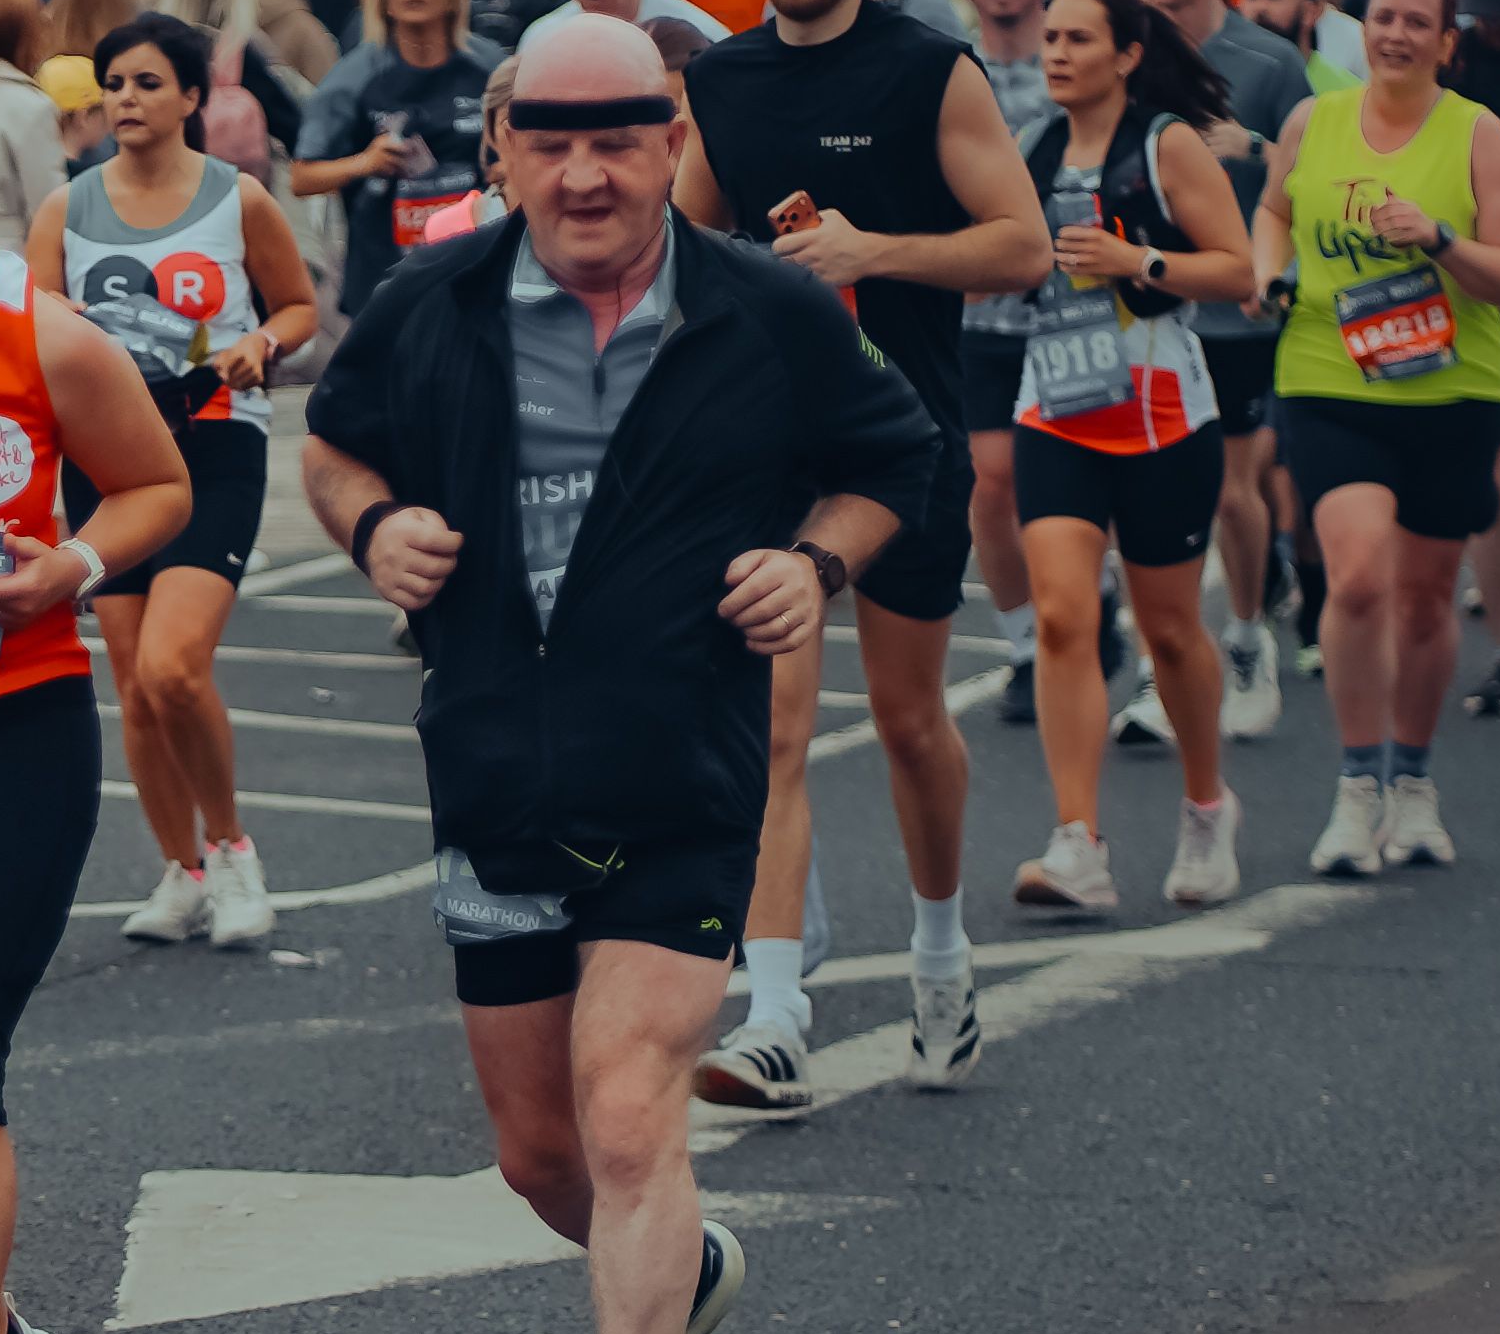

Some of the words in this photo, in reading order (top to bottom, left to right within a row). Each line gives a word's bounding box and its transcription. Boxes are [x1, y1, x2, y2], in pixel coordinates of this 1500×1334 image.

[172, 270, 205, 307] R
[519, 401, 555, 416] sher
[519, 470, 595, 505] RISH
[446, 898, 541, 930] MARATHON
